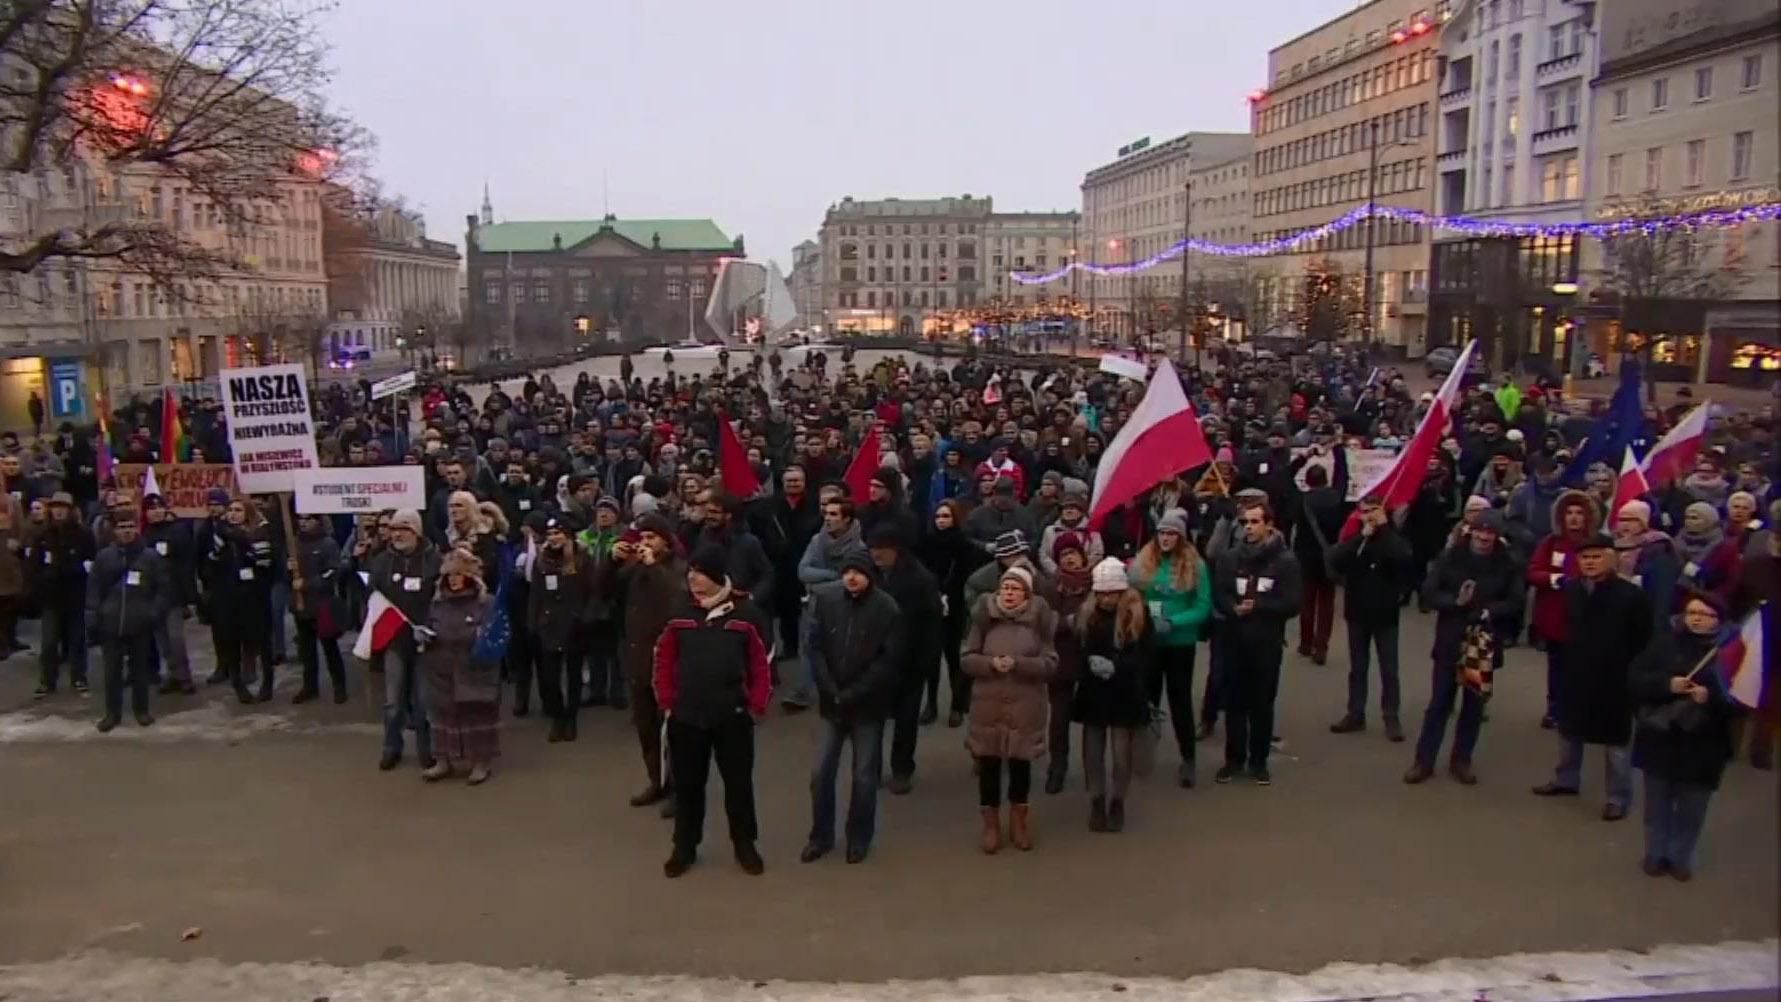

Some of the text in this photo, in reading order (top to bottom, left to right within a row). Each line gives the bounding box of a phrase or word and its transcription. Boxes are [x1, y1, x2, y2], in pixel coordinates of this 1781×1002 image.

[61, 379, 76, 413] P
[229, 374, 302, 402] NASZA
[341, 497, 372, 508] TROSKI
